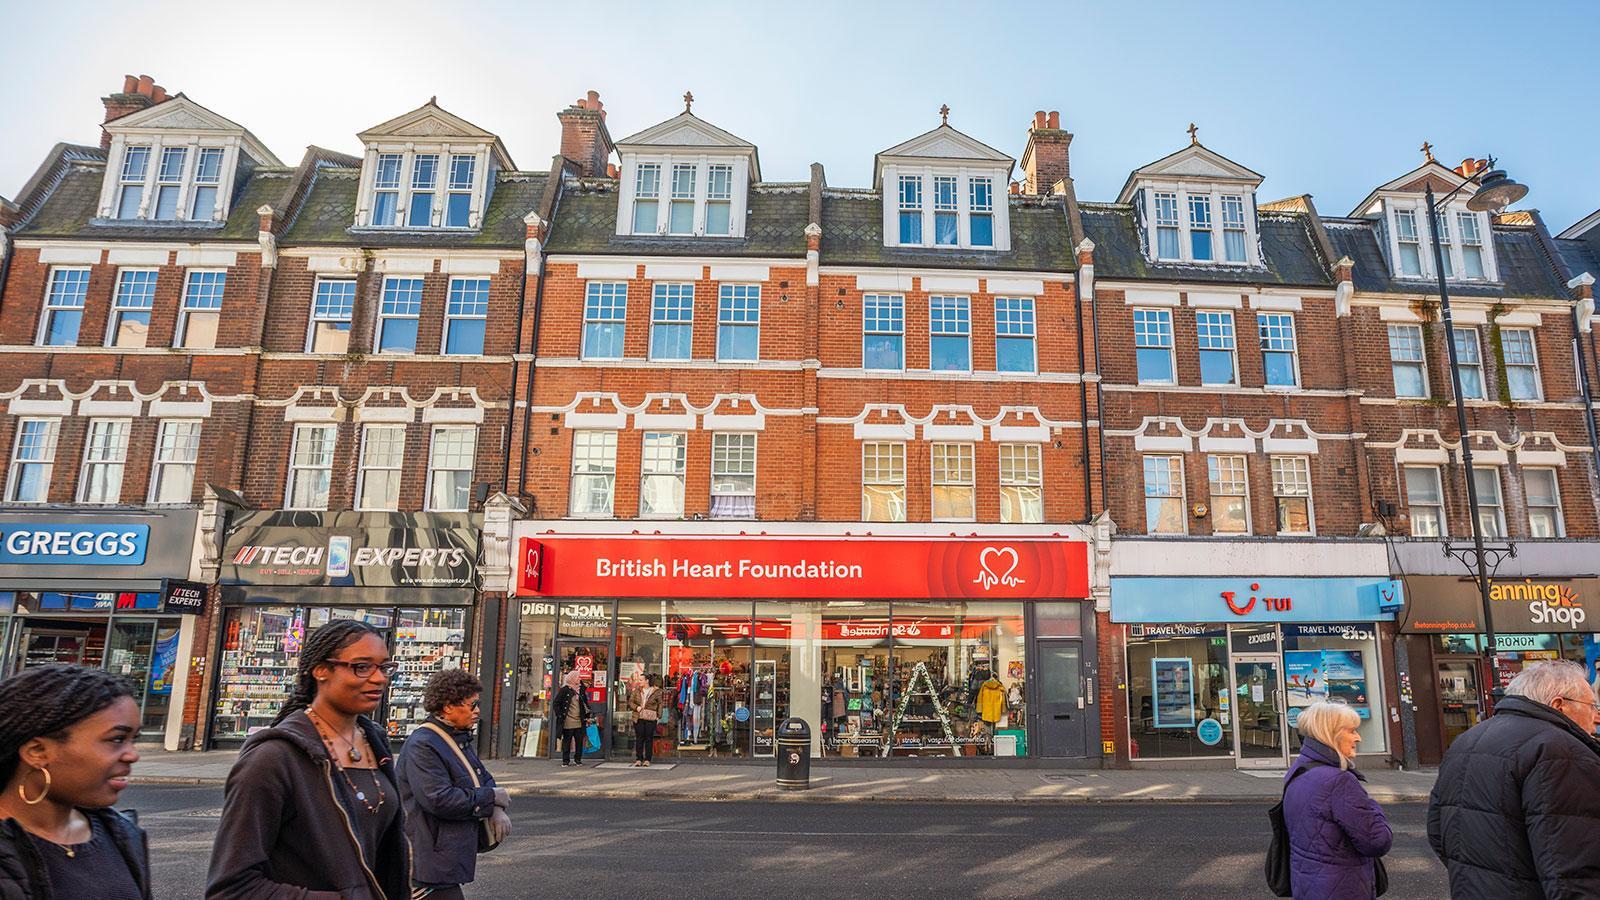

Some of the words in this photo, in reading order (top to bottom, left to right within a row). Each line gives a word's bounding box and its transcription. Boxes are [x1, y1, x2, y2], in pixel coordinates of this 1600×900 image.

[6, 530, 138, 556] GREGGS
[353, 547, 465, 568] EXPERTS
[596, 558, 666, 577] British
[673, 559, 733, 578] Heart
[739, 559, 862, 579] Foundation
[1488, 578, 1561, 607] anning
[168, 595, 202, 607] EXPERTS
[1262, 597, 1292, 611] TUI
[1529, 600, 1585, 629] Shop
[1145, 626, 1176, 635] TRAVEL
[1177, 626, 1206, 635] MONEY
[1298, 626, 1328, 634] TRAVEL
[1329, 625, 1356, 634] MONEY
[832, 736, 850, 744] heart
[902, 736, 921, 744] stroke
[1104, 742, 1113, 752] H
